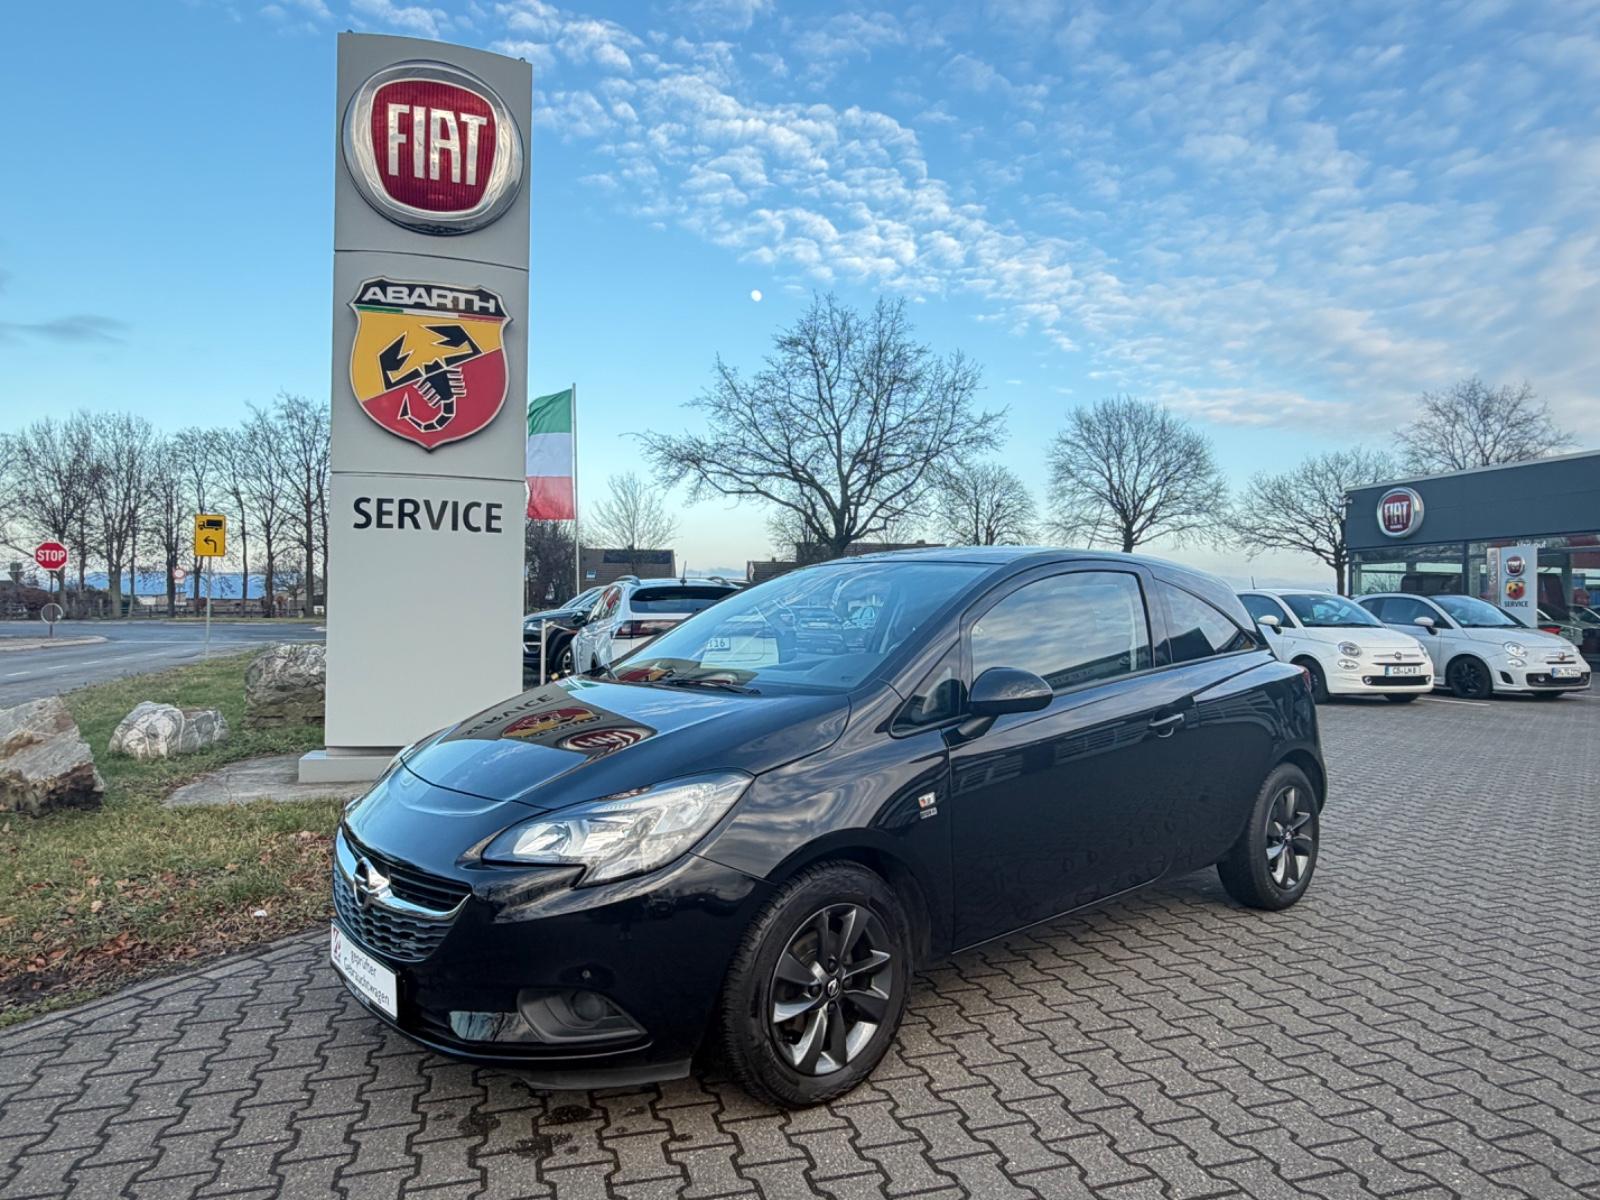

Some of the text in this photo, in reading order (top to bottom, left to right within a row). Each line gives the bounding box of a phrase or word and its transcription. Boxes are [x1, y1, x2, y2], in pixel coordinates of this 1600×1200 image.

[387, 103, 487, 186] FIAT
[361, 286, 496, 313] ABARTH
[352, 496, 503, 534] SERVICE
[1384, 501, 1409, 525] FIAT
[37, 550, 66, 562] STOP
[1504, 600, 1529, 608] SERVICE
